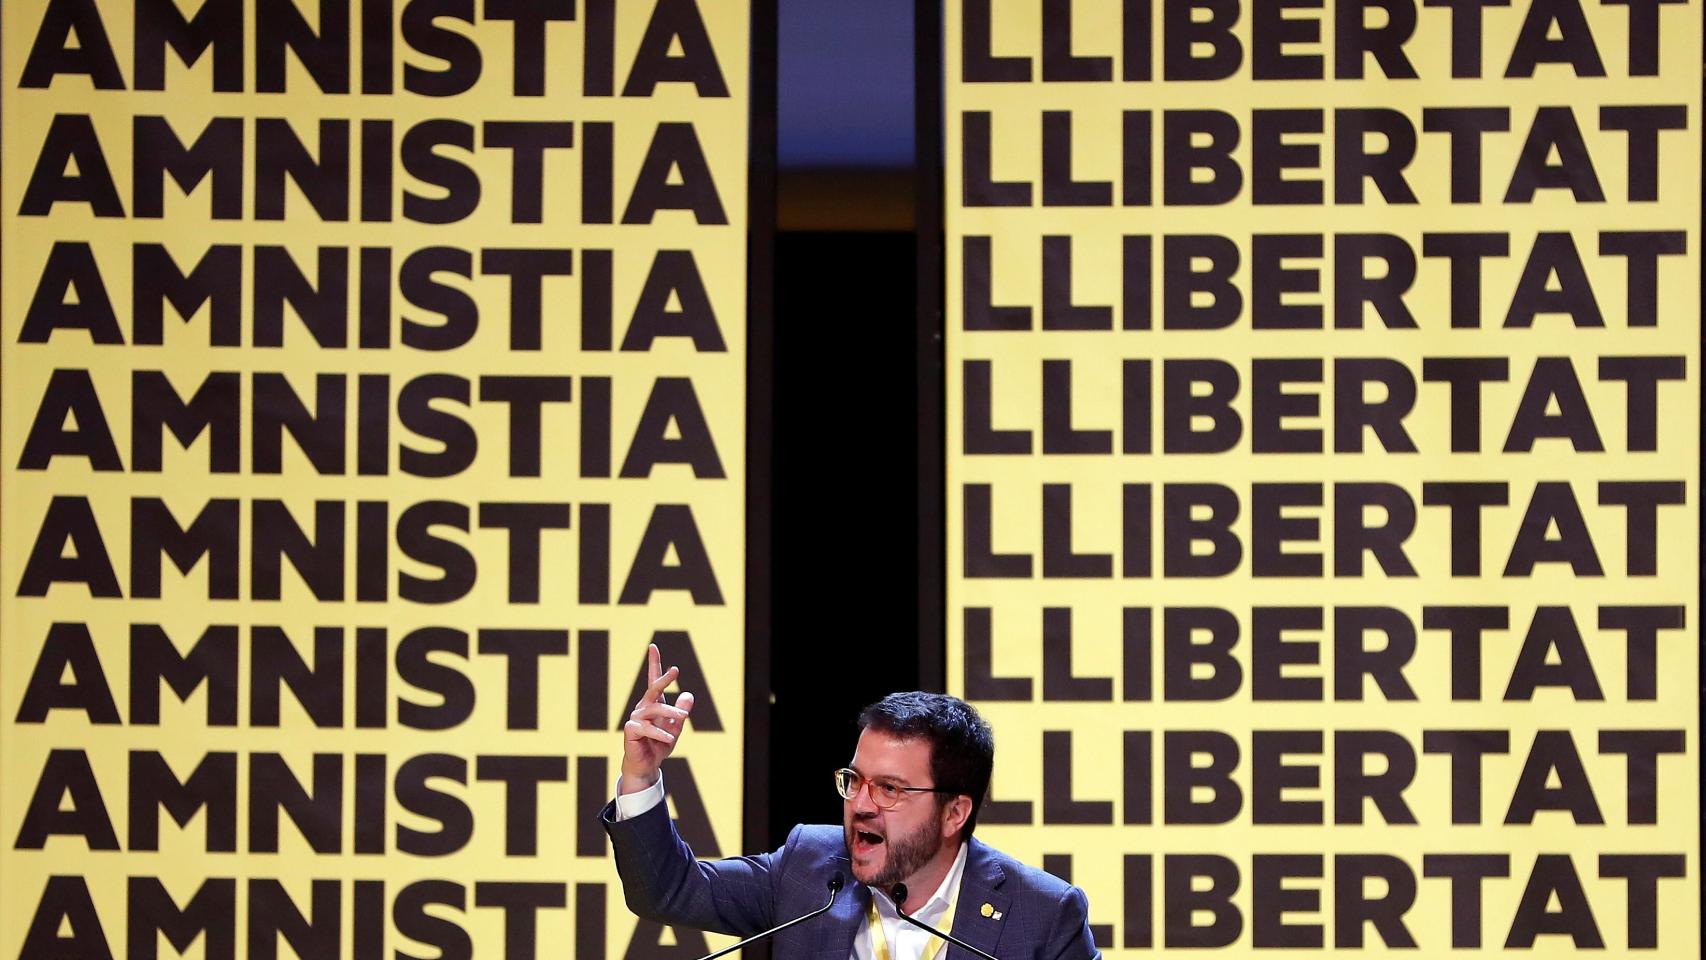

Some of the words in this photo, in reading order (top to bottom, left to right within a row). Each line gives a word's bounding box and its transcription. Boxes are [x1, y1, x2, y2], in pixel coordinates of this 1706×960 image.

[18, 0, 730, 97] AMNISTIA
[962, 0, 1688, 83] LLIBERTAT
[18, 113, 728, 225] AMNISTIA
[962, 105, 1687, 207] LLIBERTAT
[17, 241, 727, 352] AMNISTIA
[962, 231, 1686, 331] LLIBERTAT
[17, 369, 726, 478] AMNISTIA
[963, 356, 1686, 454] LLIBERTAT
[16, 496, 724, 605] AMNISTIA
[963, 481, 1685, 578] LLIBERTAT
[15, 622, 723, 731] AMNISTIA
[963, 606, 1685, 701] LLIBERTAT
